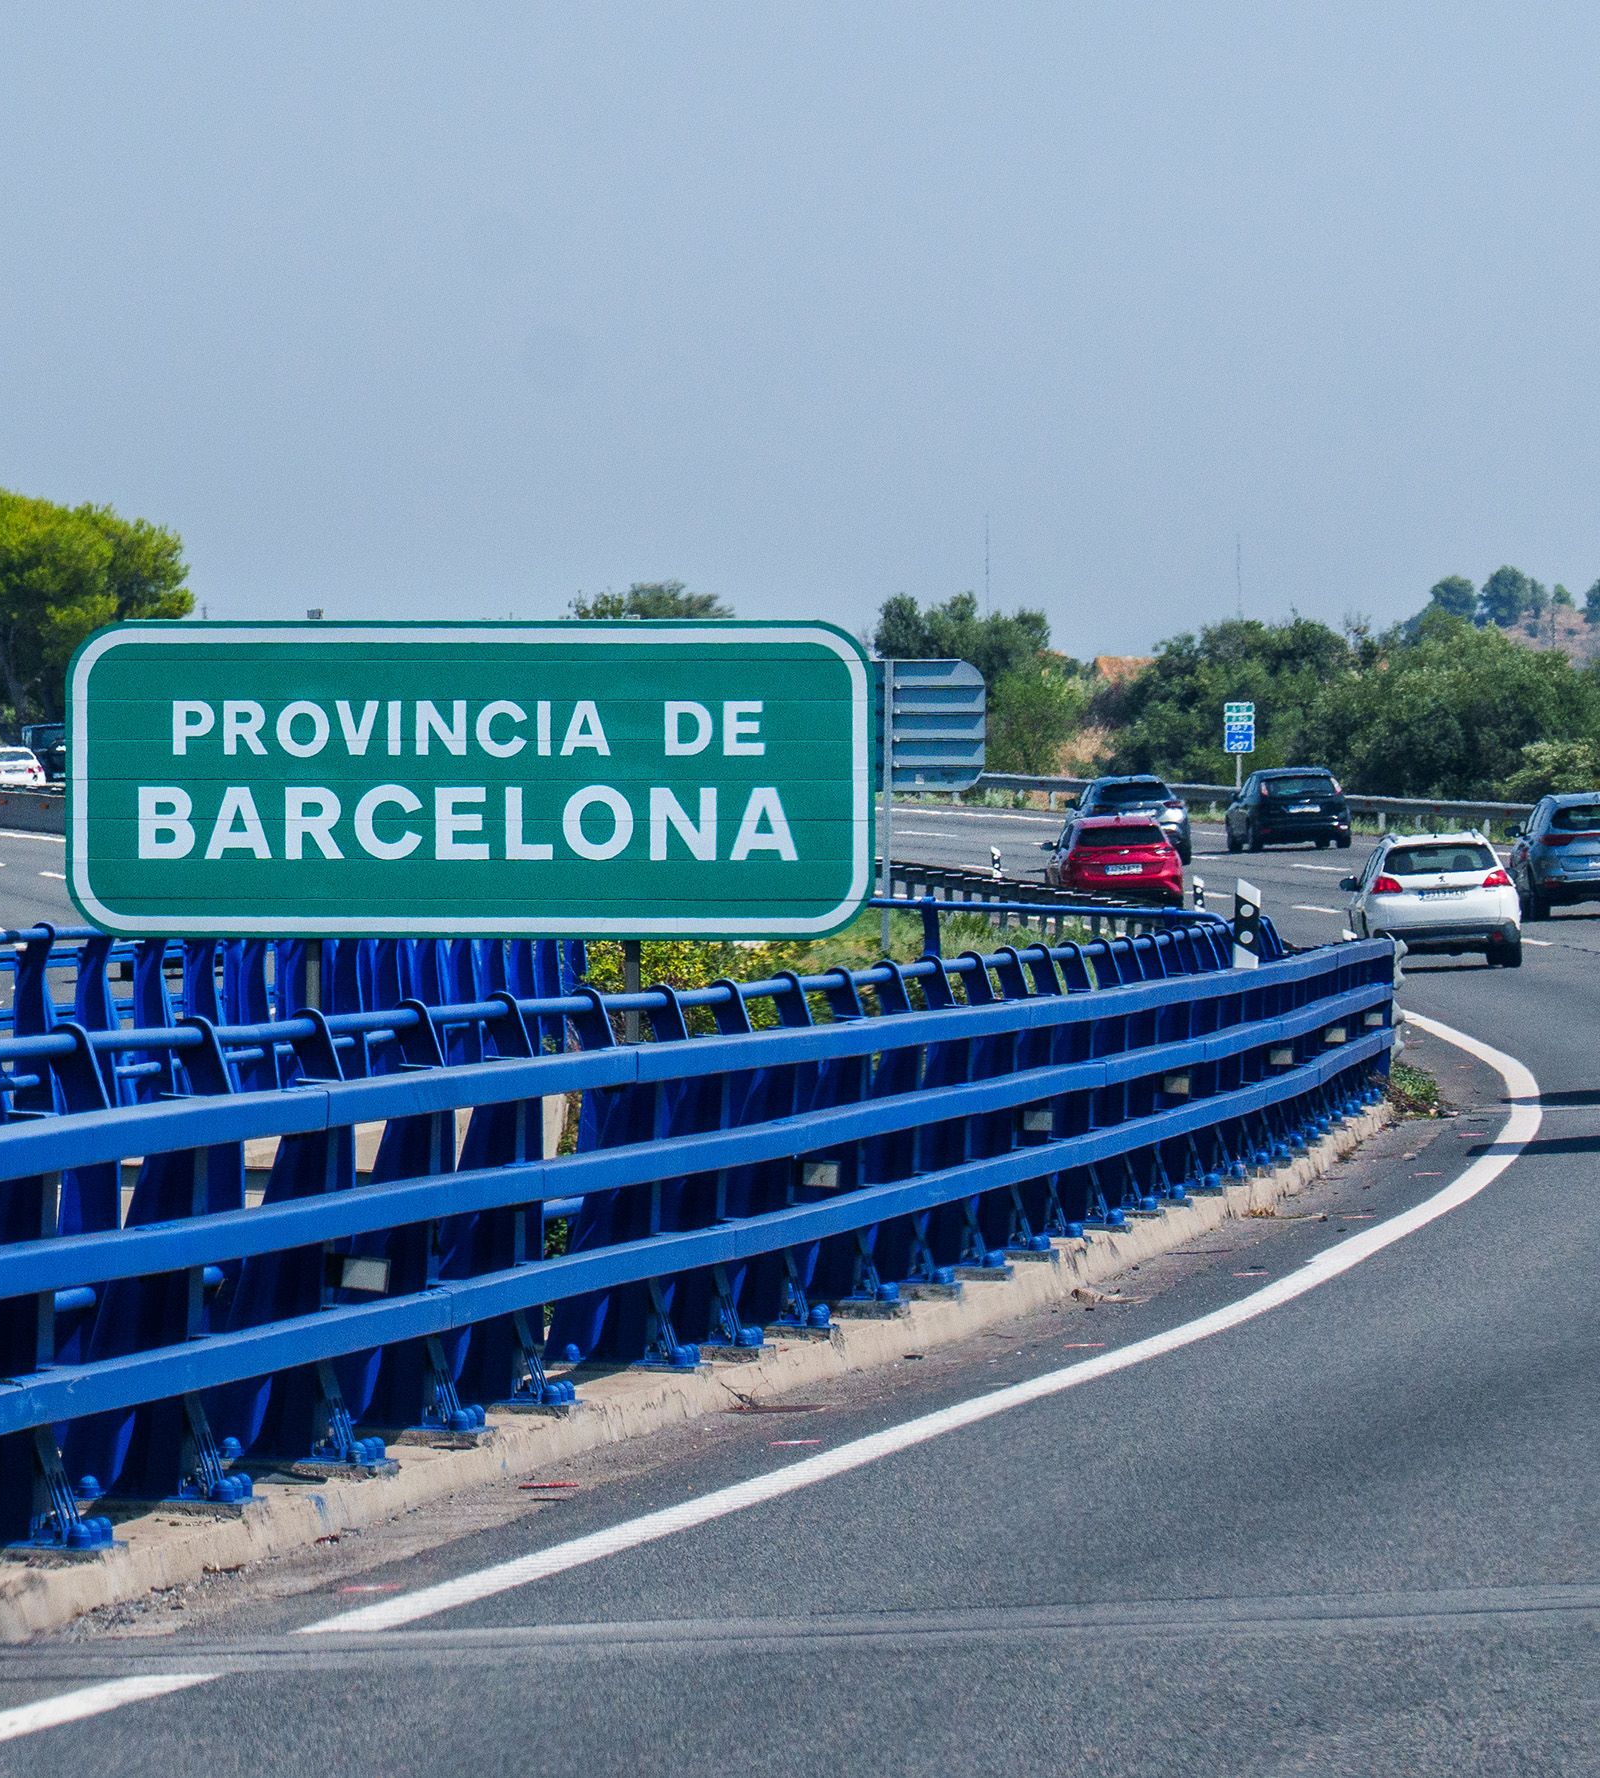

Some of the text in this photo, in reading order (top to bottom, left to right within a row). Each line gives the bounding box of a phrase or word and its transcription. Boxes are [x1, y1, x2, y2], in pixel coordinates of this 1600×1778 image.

[172, 700, 766, 758] PROVINCIA DE
[1229, 741, 1250, 750] 207
[138, 784, 799, 861] BARCELONA
